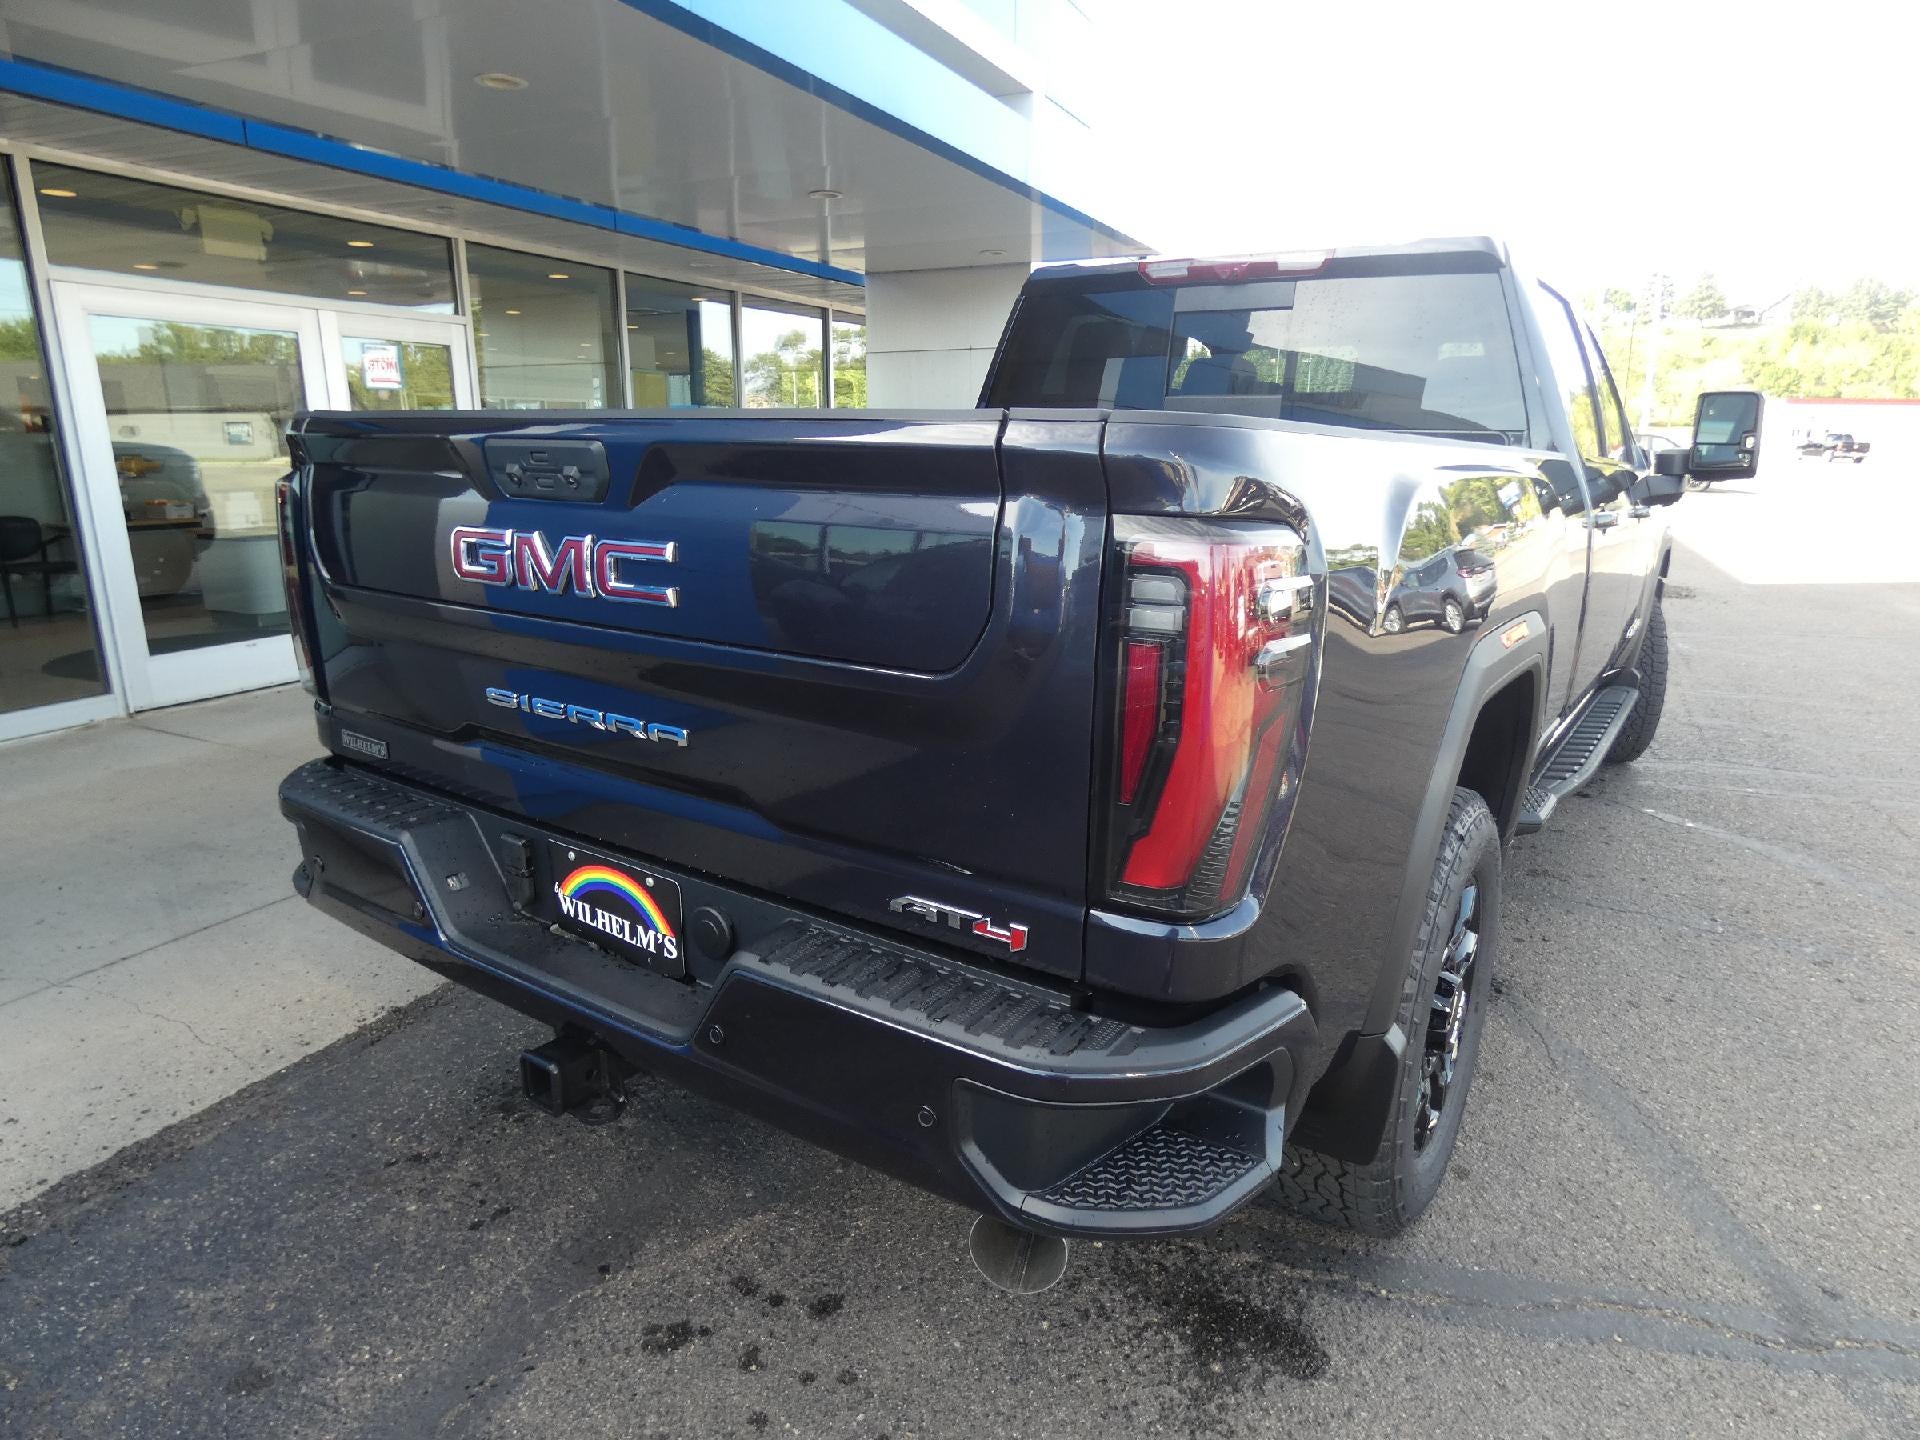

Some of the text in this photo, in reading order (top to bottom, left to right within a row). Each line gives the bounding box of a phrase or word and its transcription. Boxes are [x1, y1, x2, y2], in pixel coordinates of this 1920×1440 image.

[451, 526, 680, 608] GMC
[486, 687, 690, 747] SIERRA
[559, 893, 678, 959] WILHELM'S
[889, 895, 1029, 952] AT4
